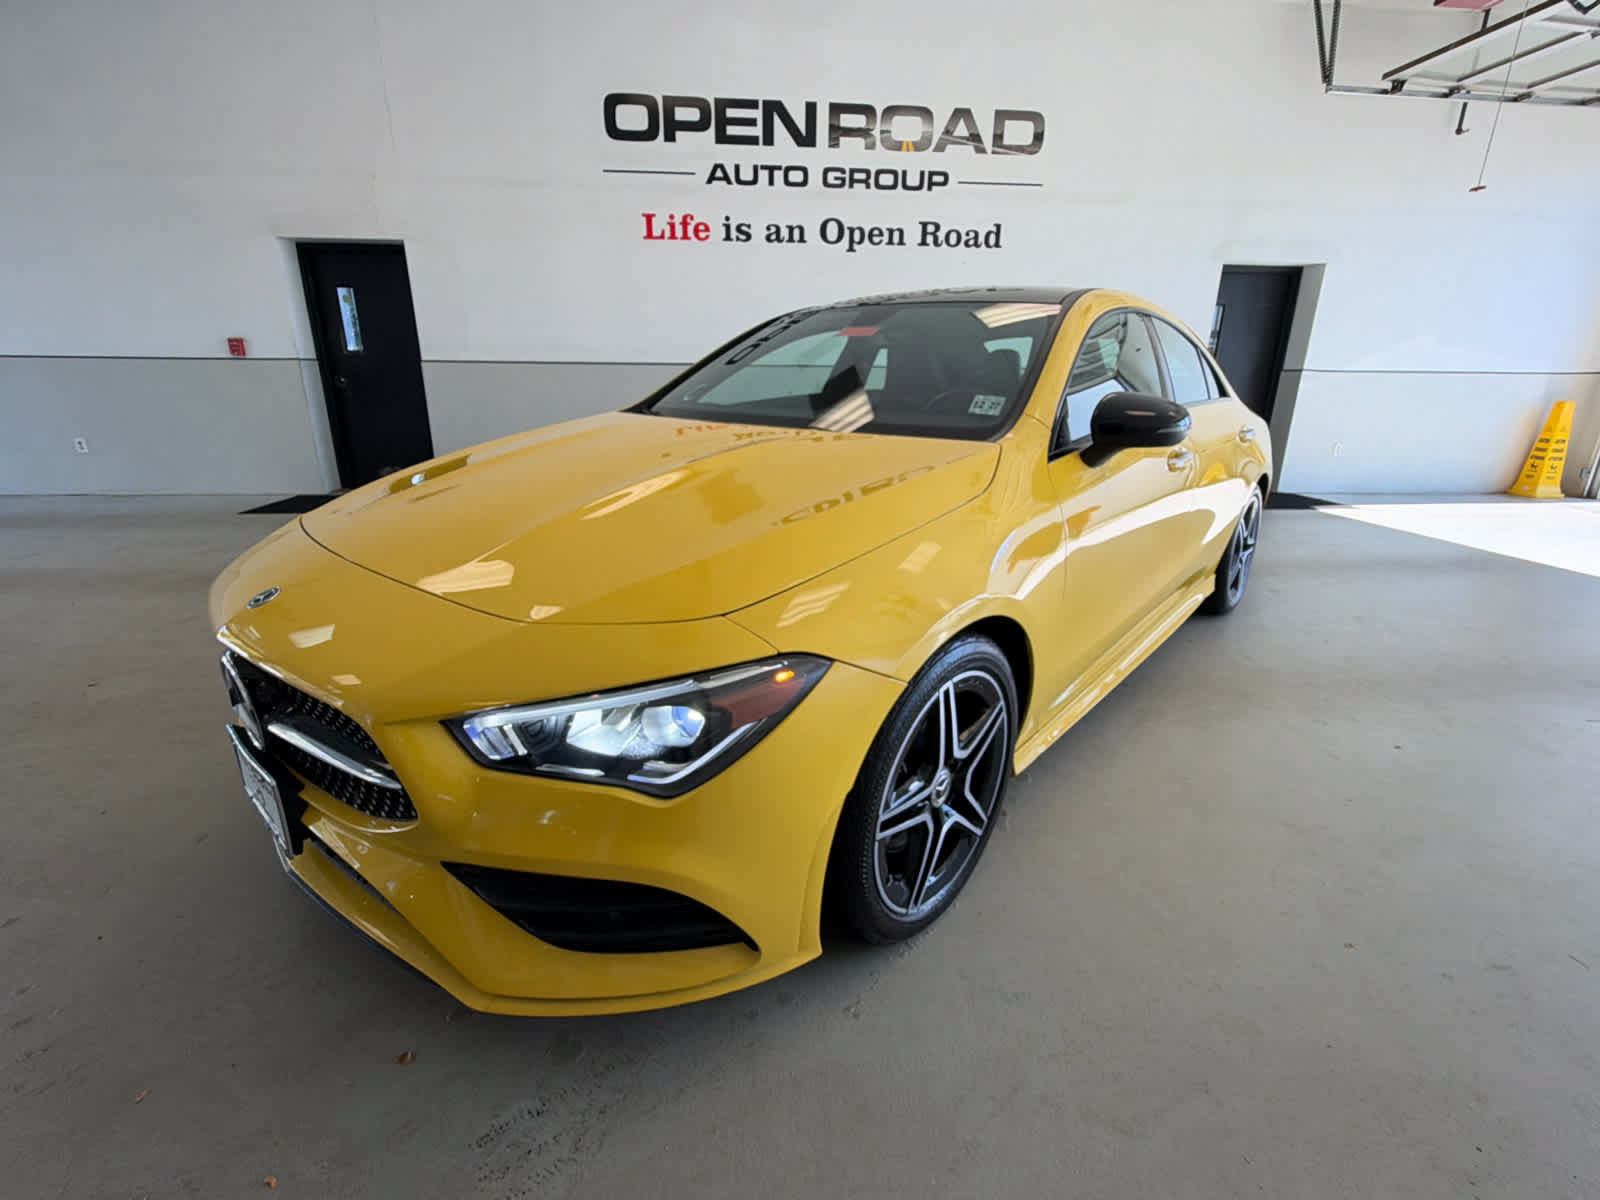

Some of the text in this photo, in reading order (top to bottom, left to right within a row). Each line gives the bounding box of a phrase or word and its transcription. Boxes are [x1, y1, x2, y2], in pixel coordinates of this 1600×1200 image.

[705, 163, 950, 191] AUTO GROUP
[642, 213, 1002, 253] Life is an Open Road
